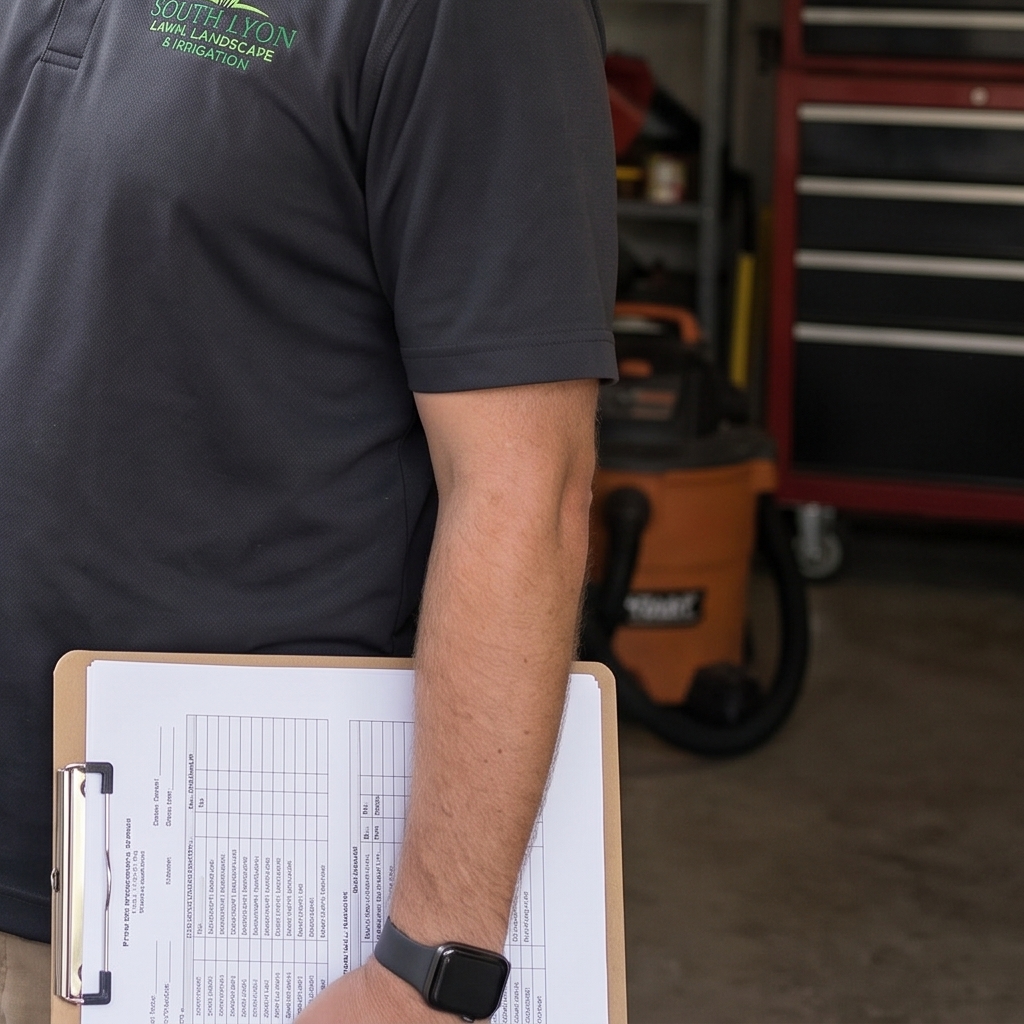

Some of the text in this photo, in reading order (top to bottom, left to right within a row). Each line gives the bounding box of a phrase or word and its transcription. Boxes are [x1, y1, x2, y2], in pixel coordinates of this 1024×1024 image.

[190, 27, 275, 62] LANDSCAPE
[226, 14, 297, 49] LYON
[172, 38, 250, 71] IRRIGATION
